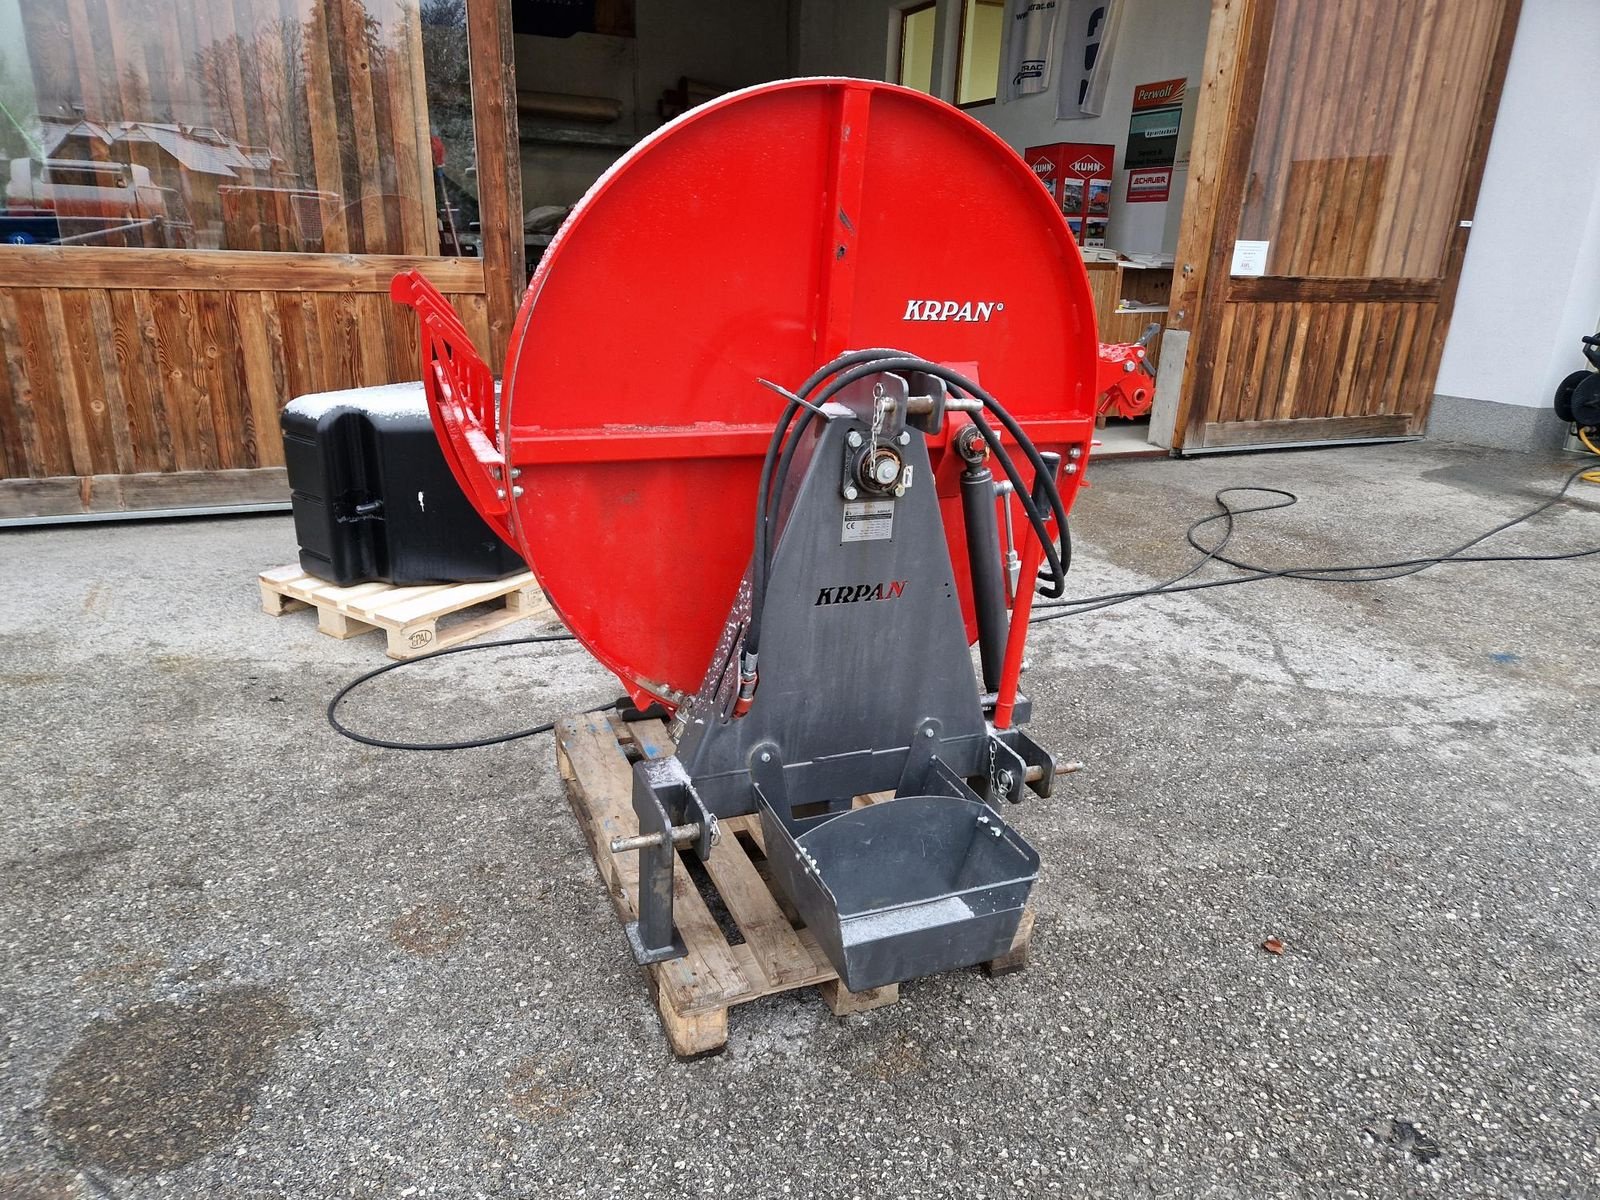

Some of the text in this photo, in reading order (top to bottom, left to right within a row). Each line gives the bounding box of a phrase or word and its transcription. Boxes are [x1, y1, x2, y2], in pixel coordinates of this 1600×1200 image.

[1138, 83, 1174, 101] Perwolf
[1033, 163, 1051, 173] KUHN
[1074, 162, 1100, 172] KUHN
[1133, 176, 1166, 185] SCHAUER
[814, 579, 909, 607] KRPAN
[411, 632, 429, 647] EPAL
